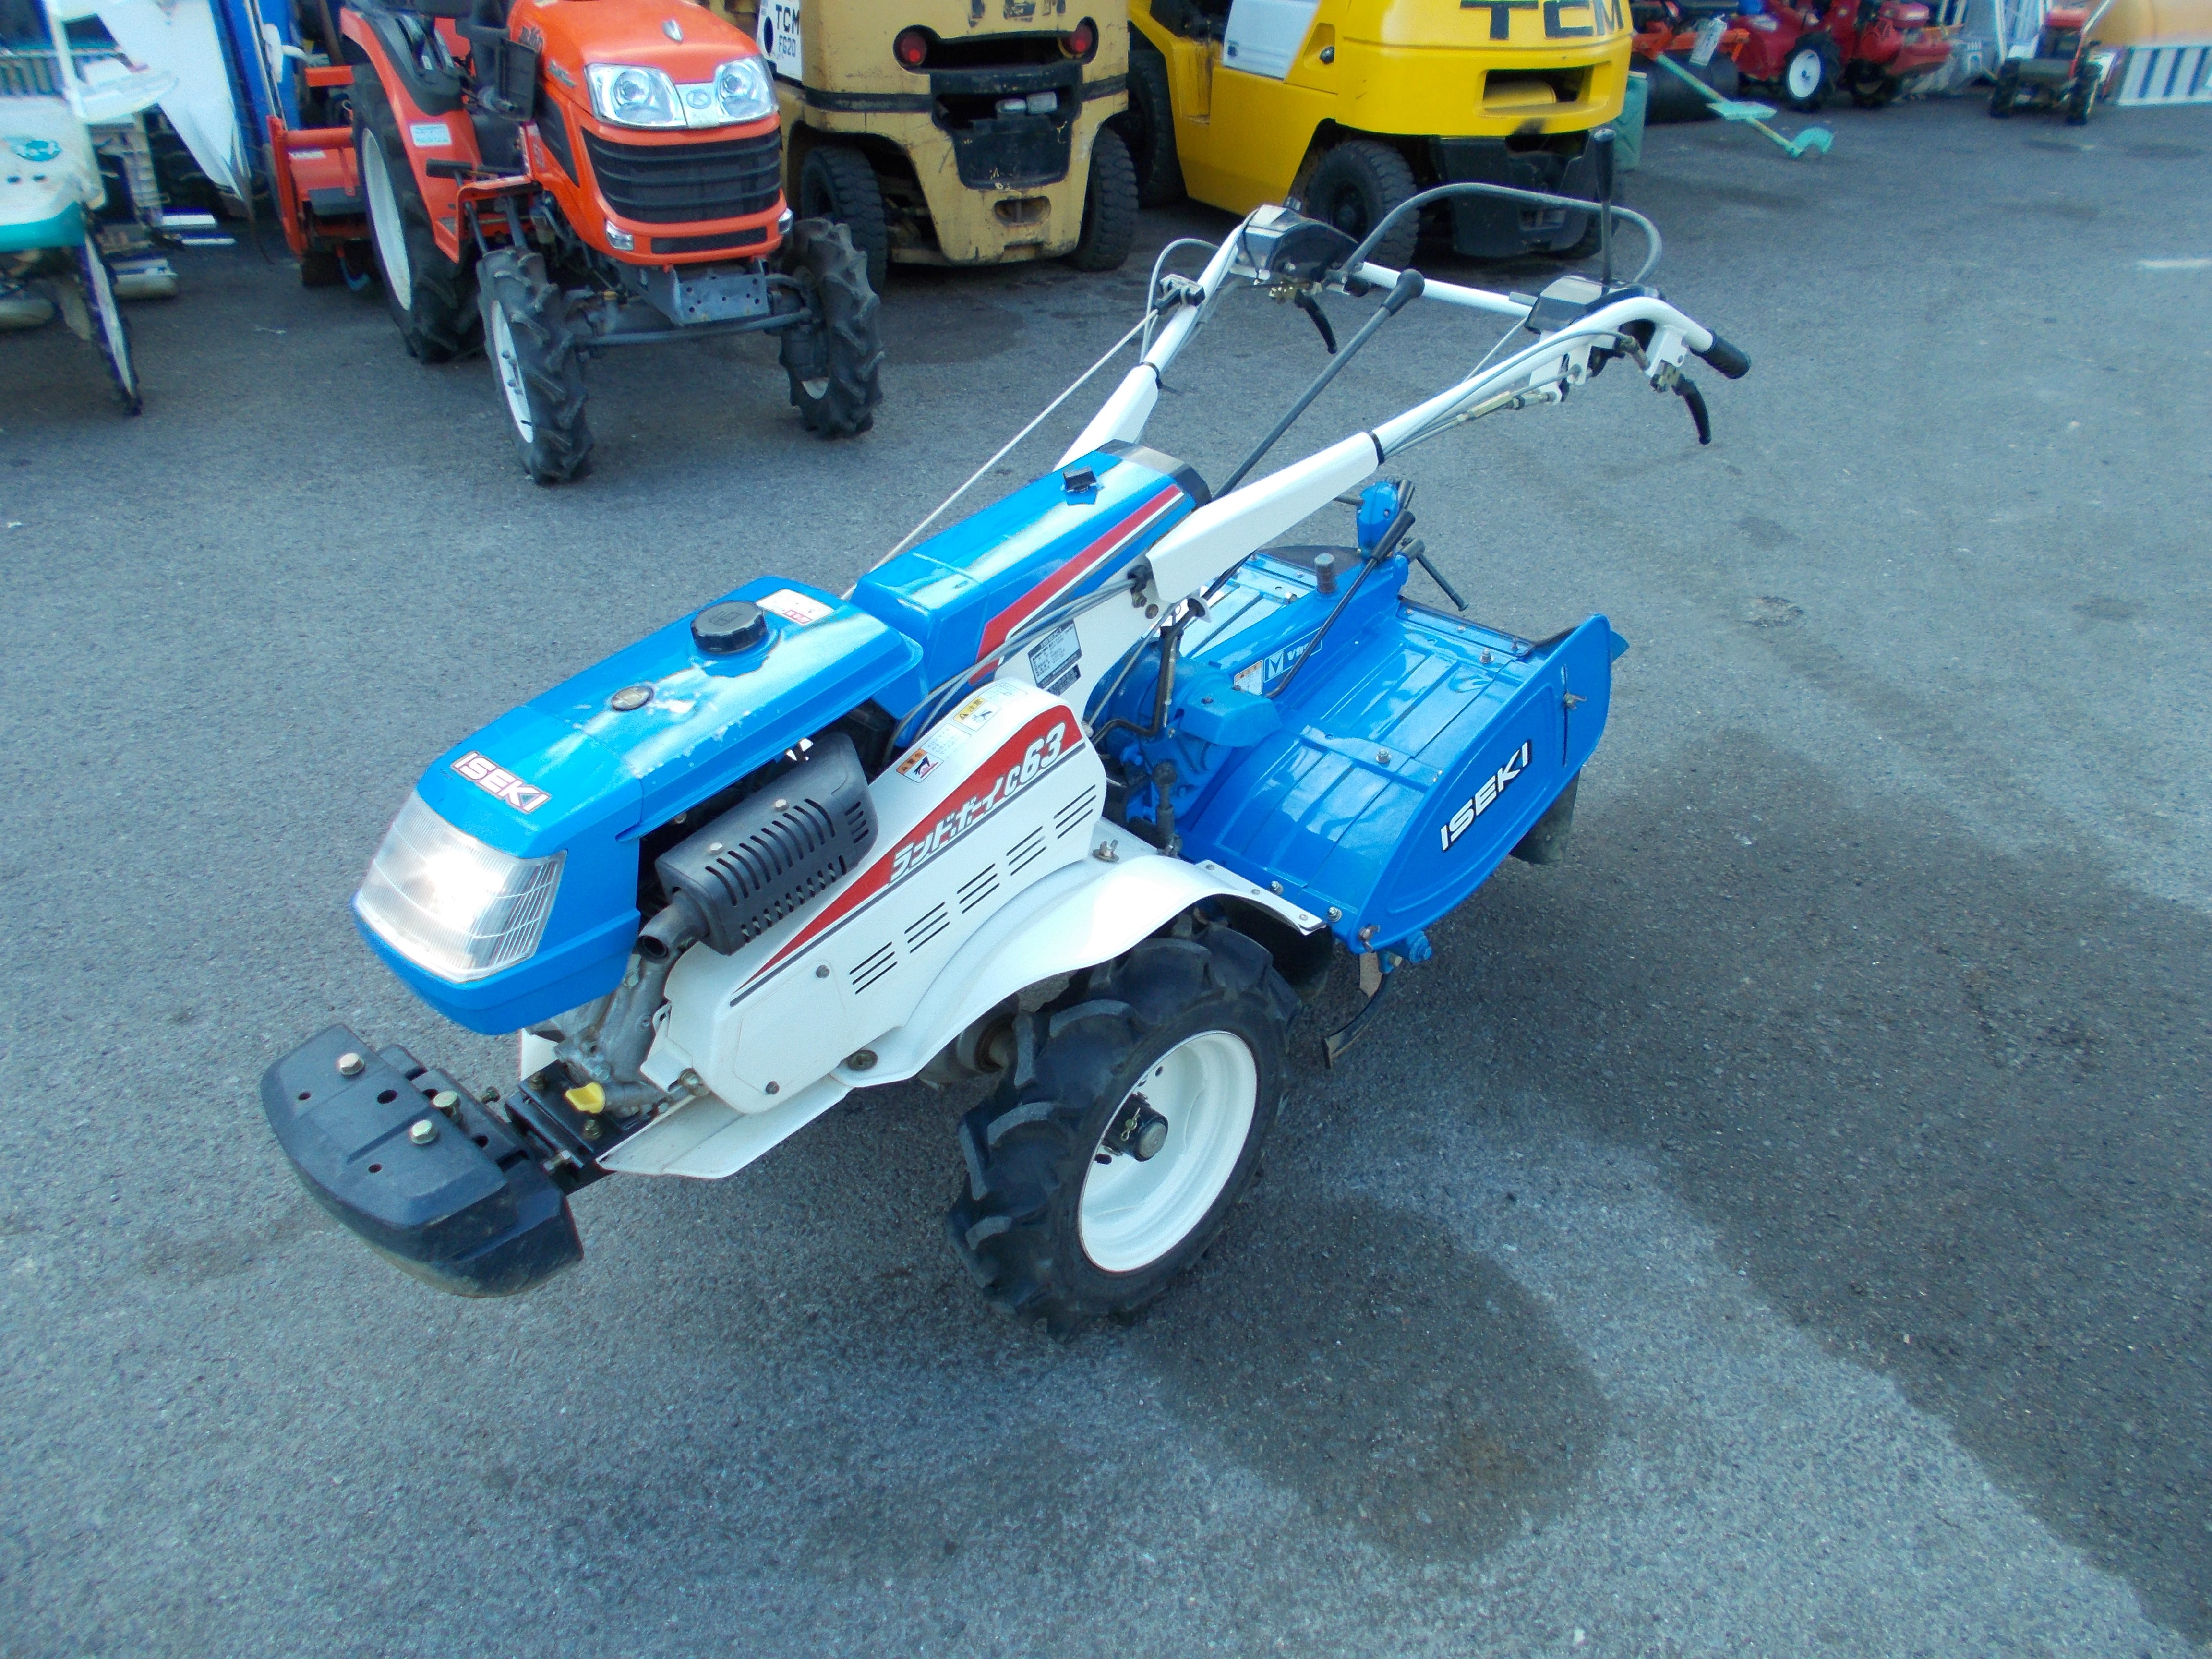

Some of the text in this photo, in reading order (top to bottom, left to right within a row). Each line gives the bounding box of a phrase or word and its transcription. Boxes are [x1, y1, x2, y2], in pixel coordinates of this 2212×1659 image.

[776, 4, 800, 35] TCM
[1460, 0, 1624, 39] TCM
[779, 35, 796, 57] FG20
[453, 752, 549, 812] ISEKI
[1441, 741, 1529, 851] ISEKI
